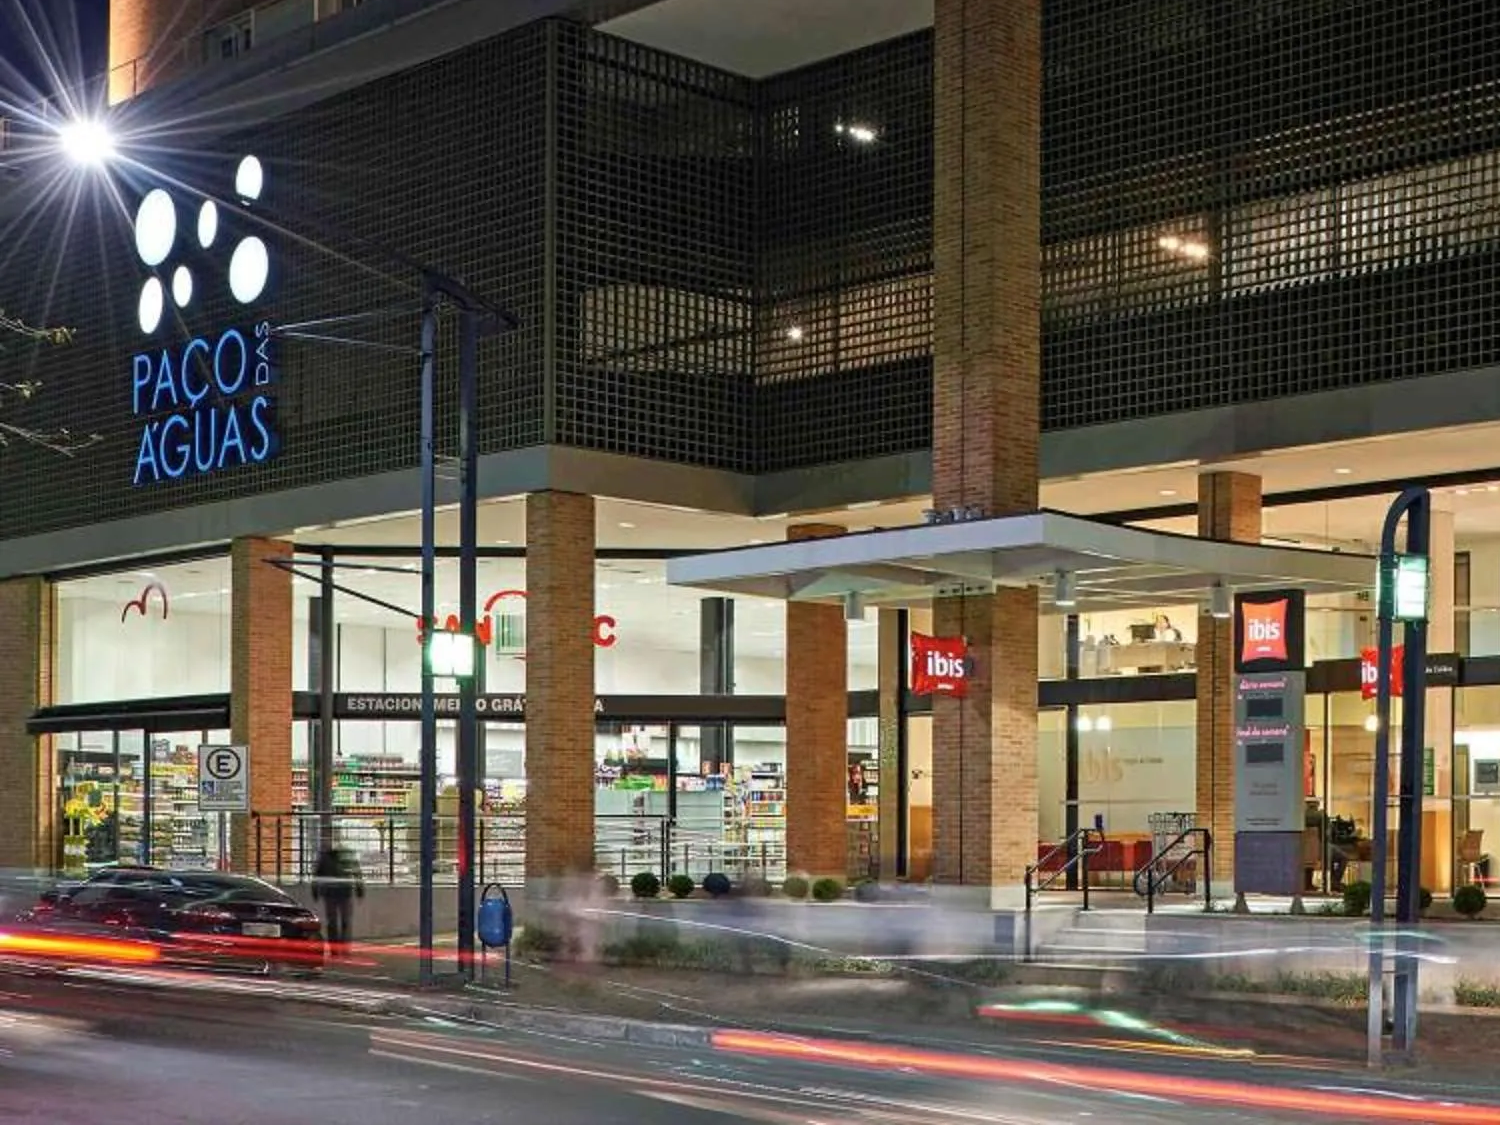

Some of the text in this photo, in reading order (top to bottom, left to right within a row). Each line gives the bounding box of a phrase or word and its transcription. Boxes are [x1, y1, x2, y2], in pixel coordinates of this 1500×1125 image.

[133, 329, 246, 414] PAÇO
[255, 320, 270, 386] DAS
[132, 395, 269, 484] ÁGUAS
[1248, 618, 1281, 641] ibis
[927, 650, 965, 678] ibis
[216, 754, 232, 773] E
